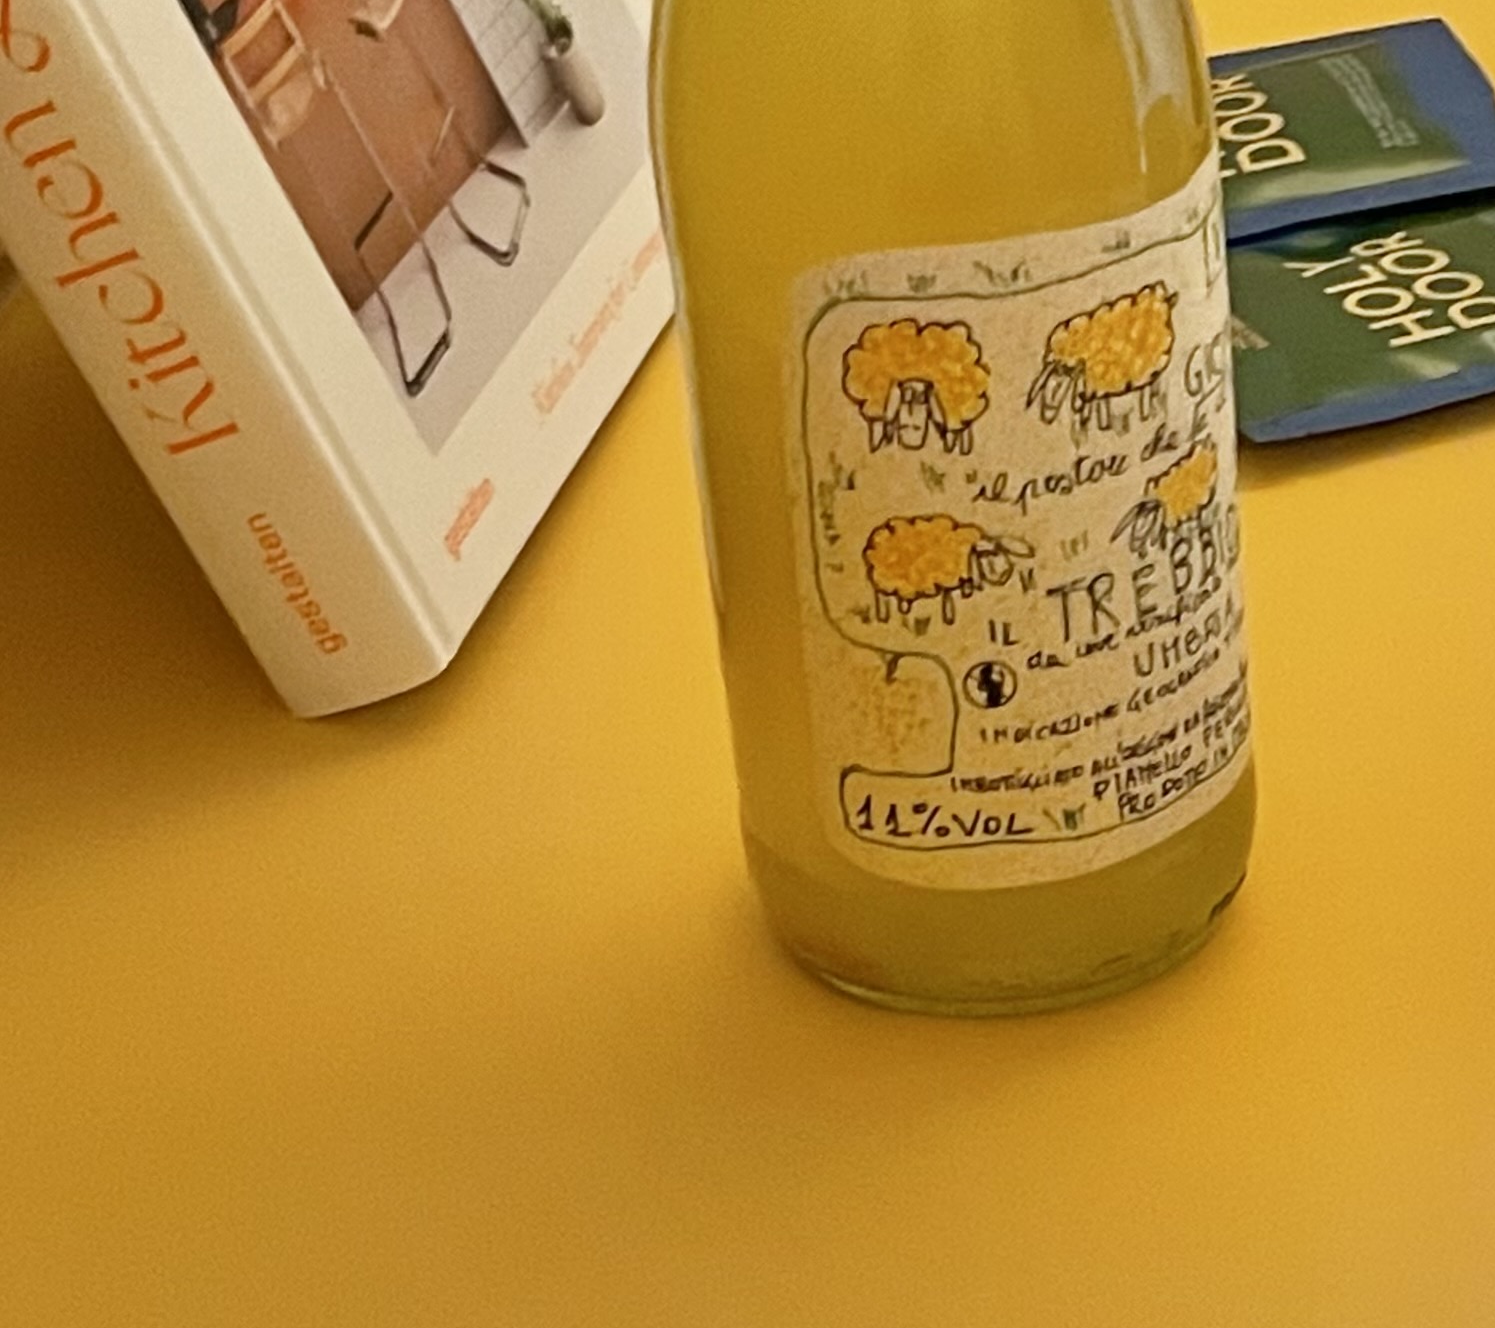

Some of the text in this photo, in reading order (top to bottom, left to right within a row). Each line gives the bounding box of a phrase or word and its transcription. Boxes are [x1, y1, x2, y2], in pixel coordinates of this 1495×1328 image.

[3, 99, 240, 458] Kitchen
[1283, 255, 1456, 348] HOLY
[247, 512, 348, 655] gestalten
